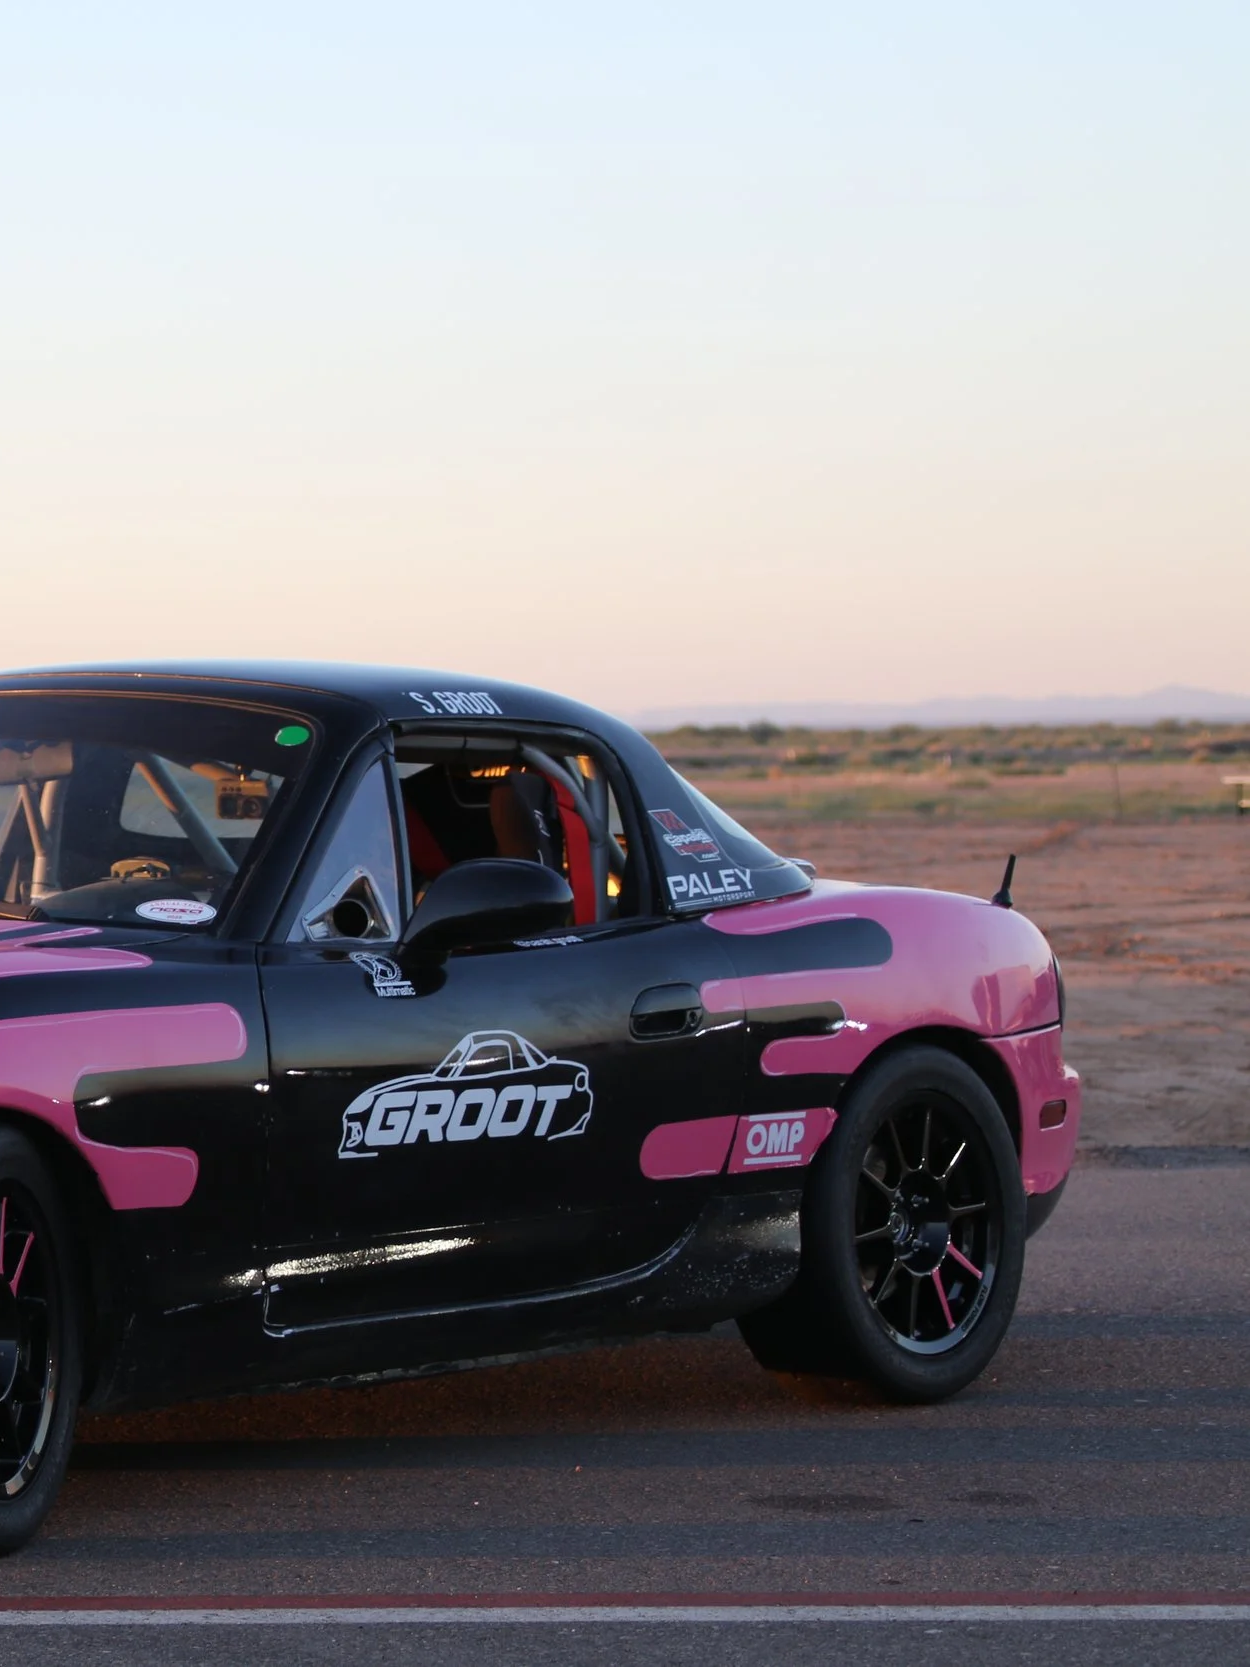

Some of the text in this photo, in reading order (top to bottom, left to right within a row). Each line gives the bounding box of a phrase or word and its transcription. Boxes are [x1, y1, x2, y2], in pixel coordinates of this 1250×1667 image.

[409, 692, 503, 715] S. GROOT
[666, 868, 753, 900] PALEY
[712, 890, 756, 903] MOTORSPORT
[374, 986, 416, 997] Multimatic
[364, 1084, 573, 1146] GROOT
[746, 1122, 806, 1155] OMP
